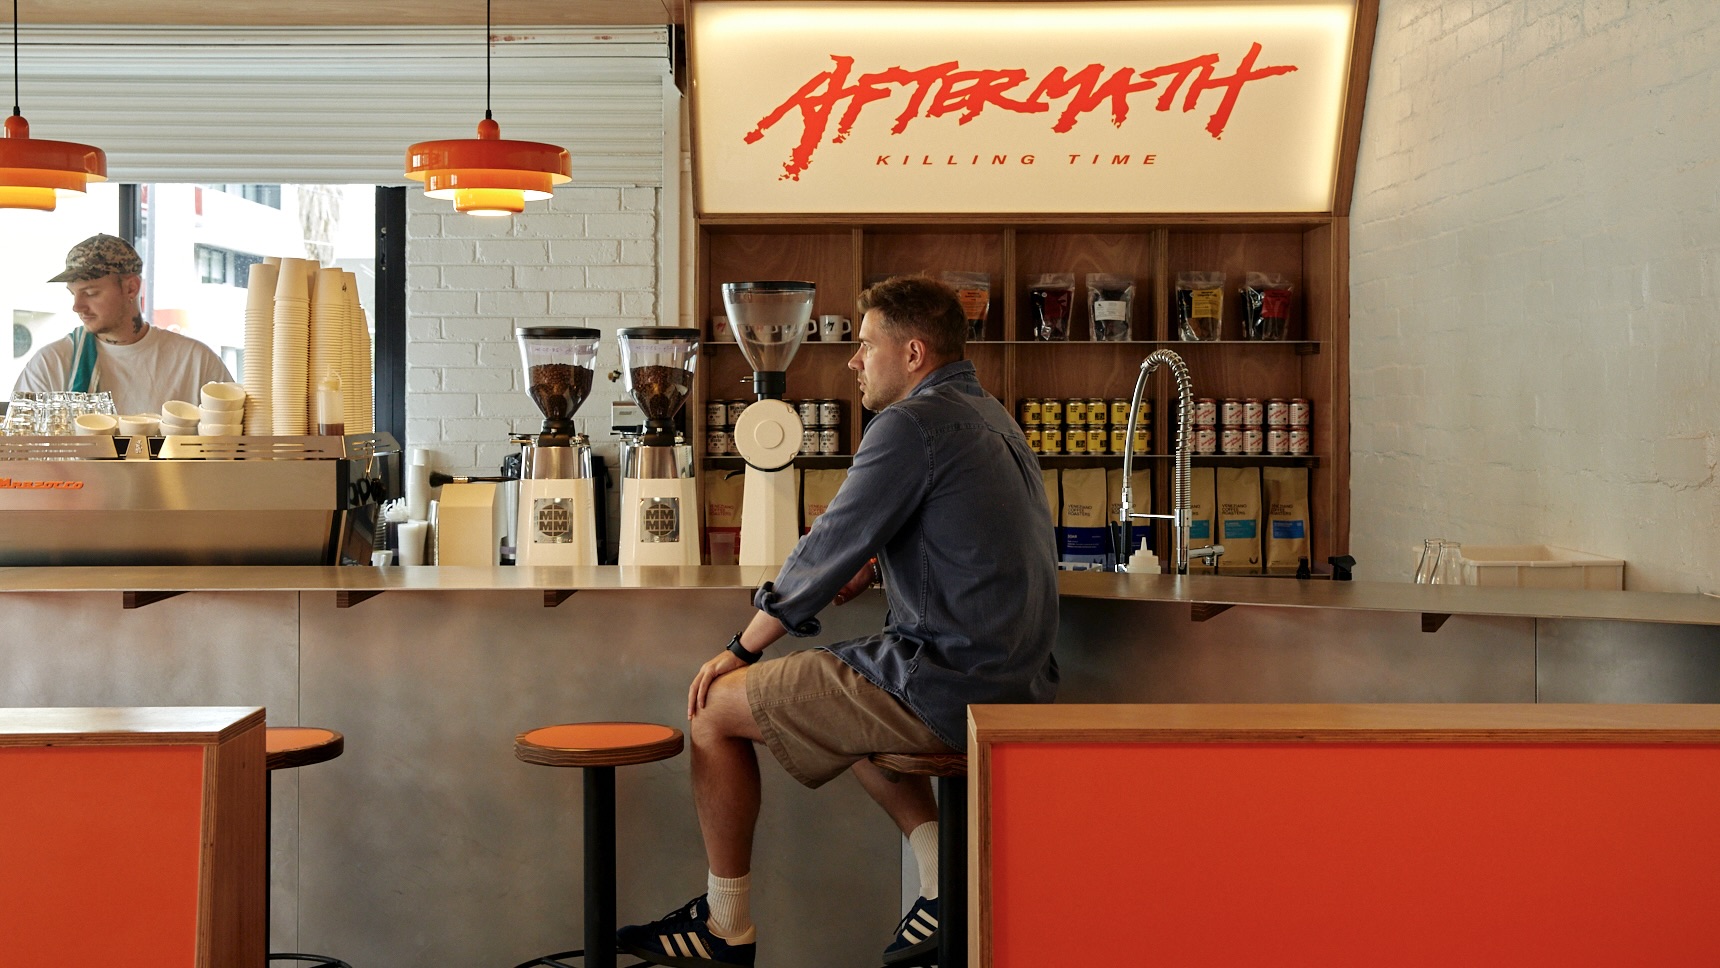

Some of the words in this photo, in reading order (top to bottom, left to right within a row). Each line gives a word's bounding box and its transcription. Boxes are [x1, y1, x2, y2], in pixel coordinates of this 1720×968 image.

[744, 42, 1298, 181] AFTERMATH
[876, 154, 1036, 166] KILLING
[1069, 153, 1158, 165] TIME
